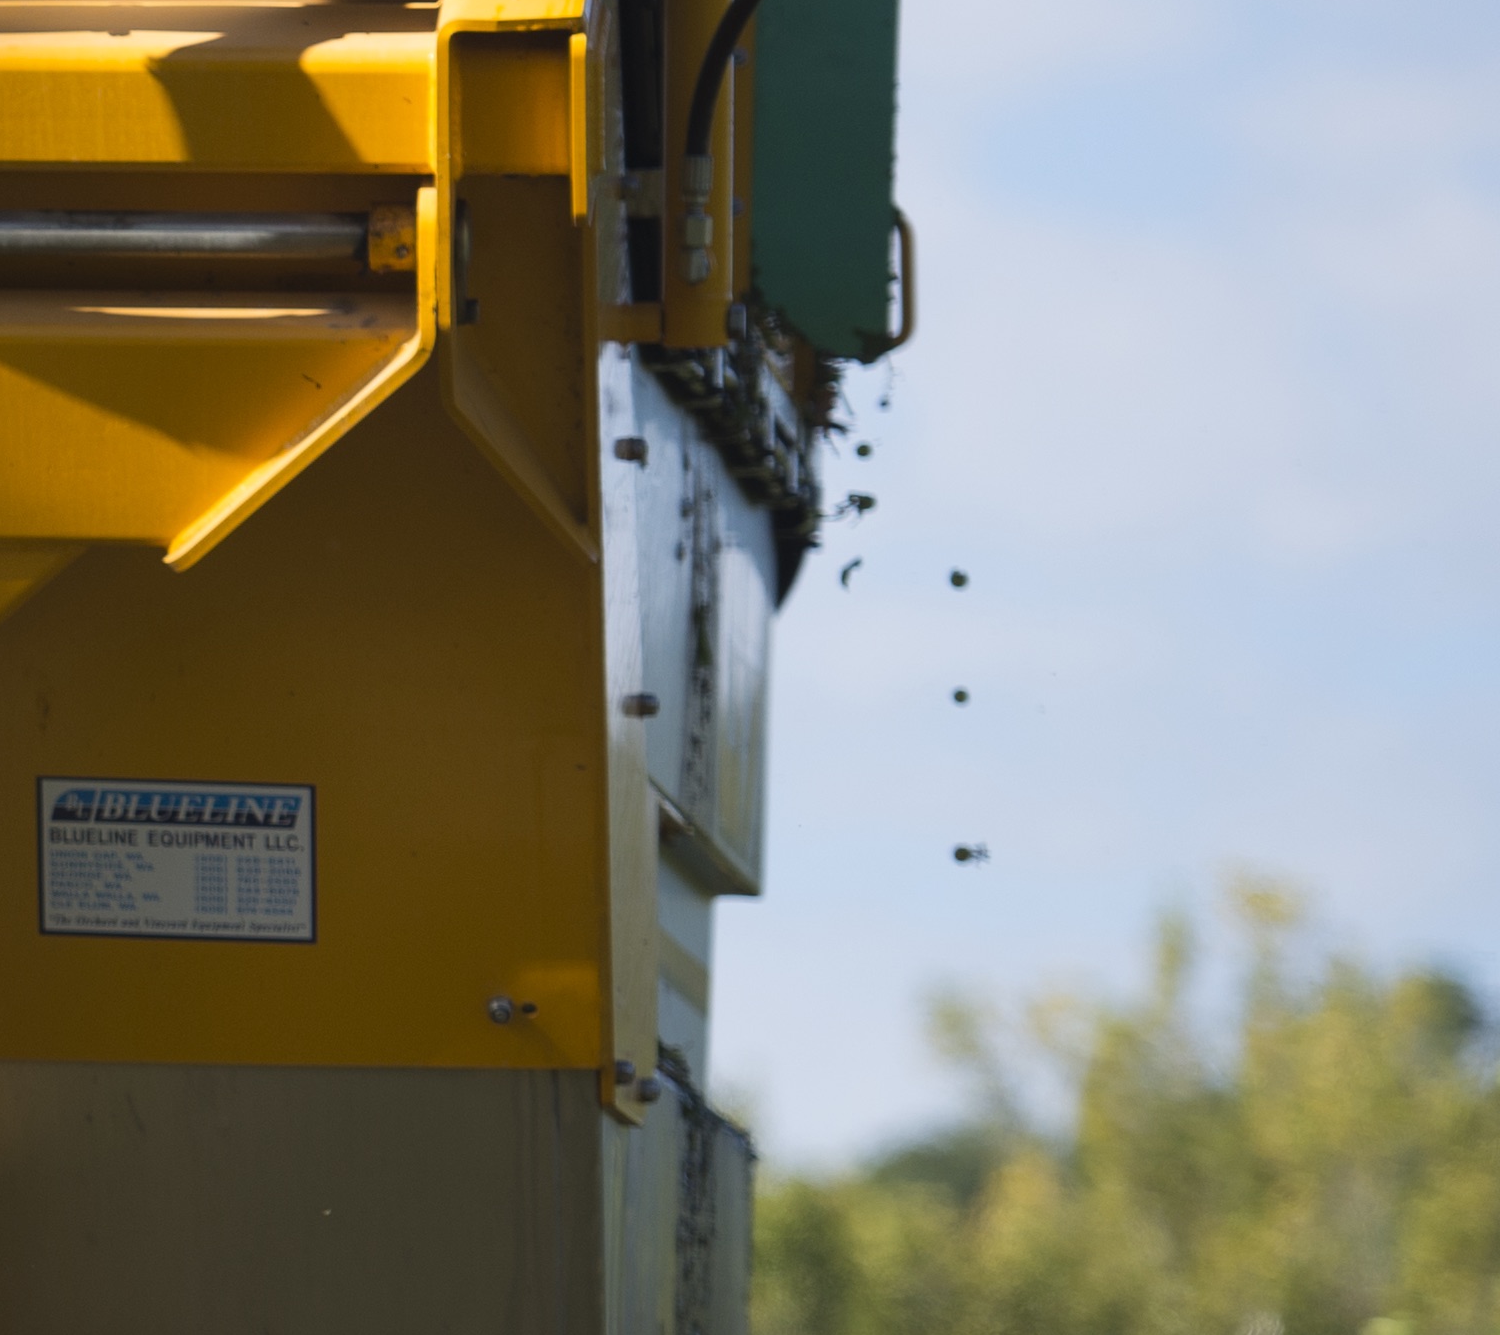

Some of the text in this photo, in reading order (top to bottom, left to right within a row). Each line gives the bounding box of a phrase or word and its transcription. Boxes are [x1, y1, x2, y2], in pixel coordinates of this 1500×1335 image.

[102, 793, 296, 826] BLUELINE
[49, 827, 138, 846] BLUELINE
[147, 830, 255, 850] EQUIPMENT
